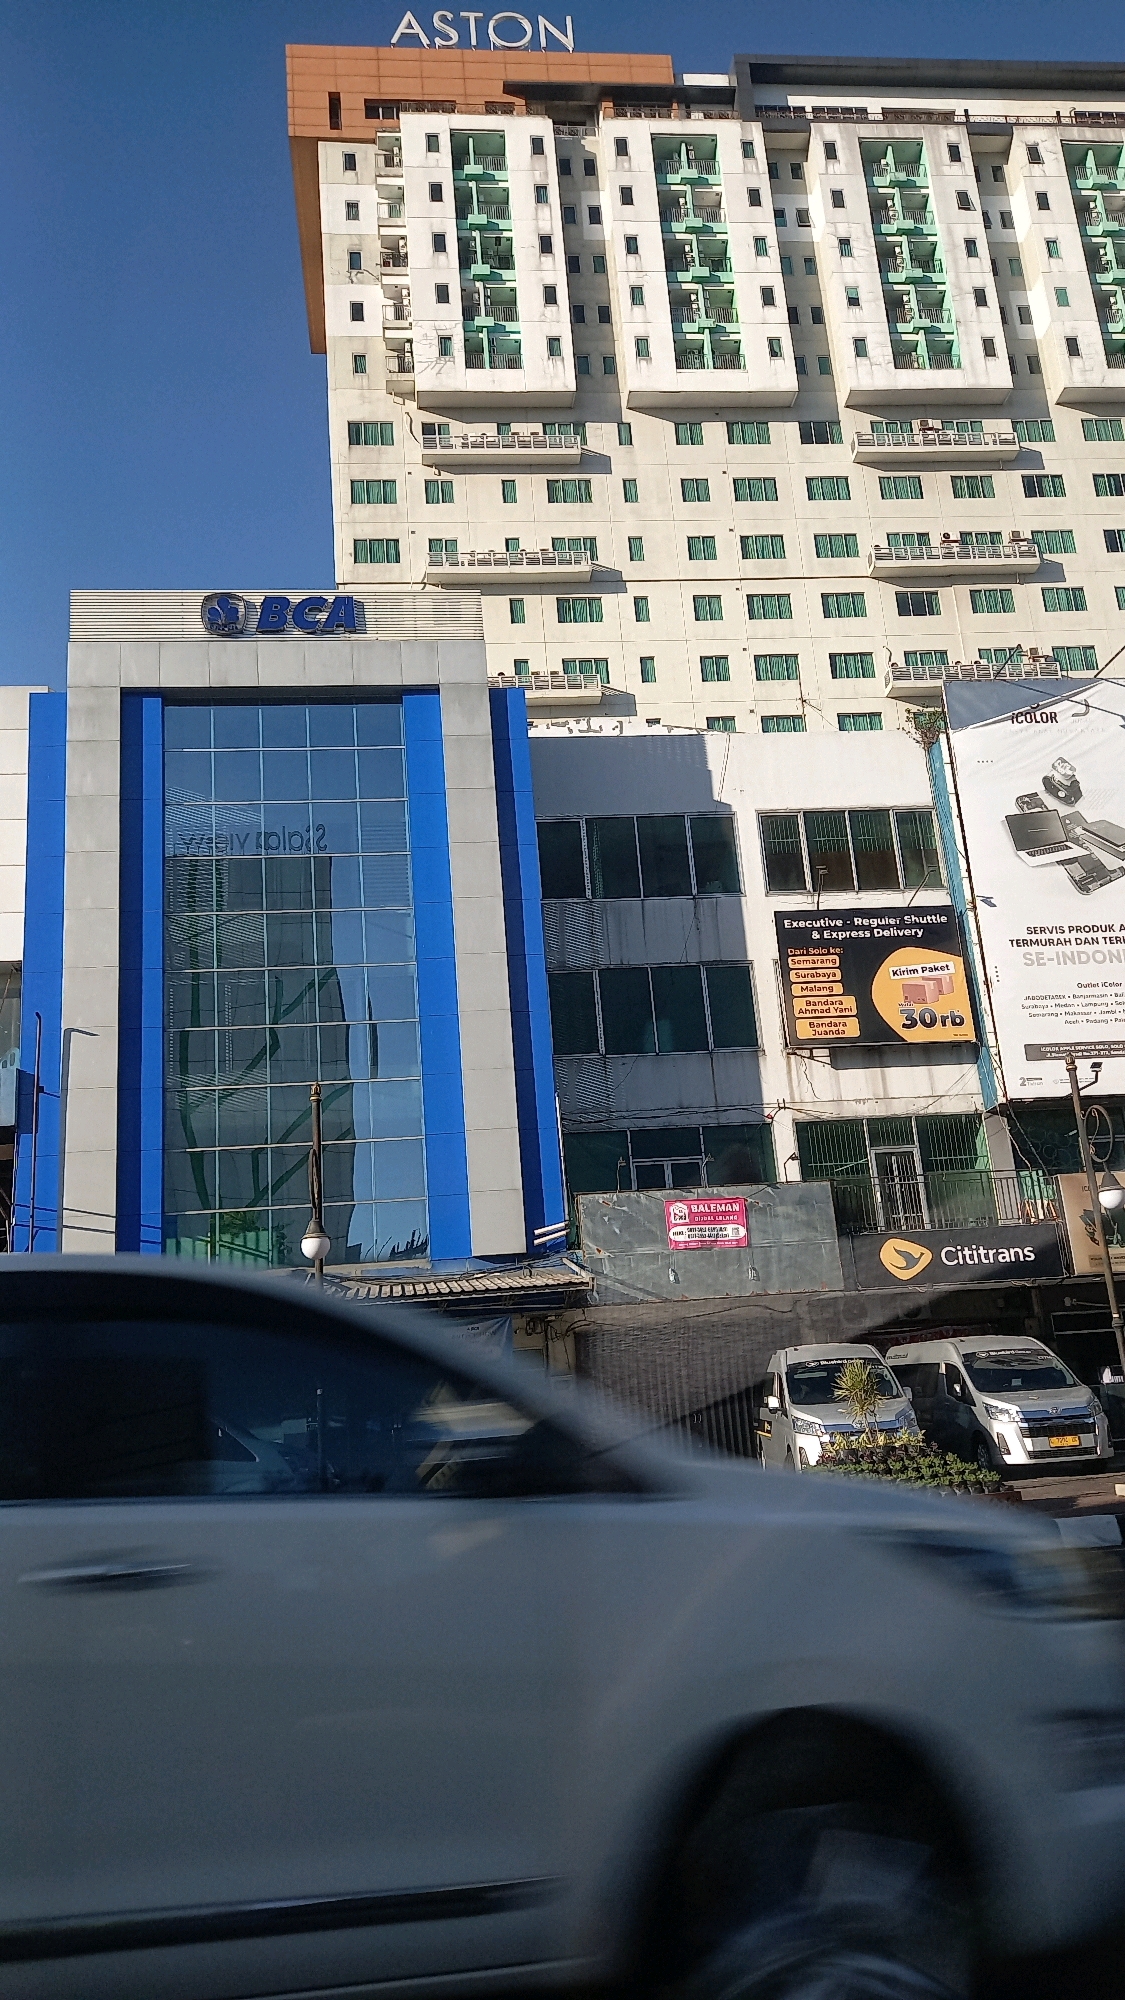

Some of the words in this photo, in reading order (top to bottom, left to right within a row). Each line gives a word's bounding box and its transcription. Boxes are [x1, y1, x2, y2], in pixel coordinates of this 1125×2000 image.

[390, 10, 574, 52] ASTON
[256, 595, 357, 633] BCA
[784, 917, 843, 928] Executive
[904, 913, 948, 924] Shuttle
[811, 930, 821, 940] &
[823, 929, 871, 940] Express
[873, 927, 924, 938] Delivery
[1026, 925, 1066, 935] SERVIS
[1067, 923, 1116, 934] PRODUK
[1008, 937, 1072, 948] TERMURAH
[1074, 936, 1100, 946] DAN
[787, 947, 807, 956] Dari
[808, 946, 828, 955] Solo
[830, 946, 844, 954] ke:
[790, 958, 837, 966] Semarang
[795, 971, 837, 979] Surabaya
[891, 966, 920, 977] Kirim
[921, 963, 951, 974] Paket
[800, 984, 834, 993] Malang
[797, 1006, 832, 1015] Ahmad
[832, 1005, 853, 1013] Yani
[808, 1020, 848, 1028] Bandara
[811, 1028, 846, 1036] Juanda
[690, 1202, 740, 1213] BALEMAN
[940, 1244, 1036, 1266] Cititrans
